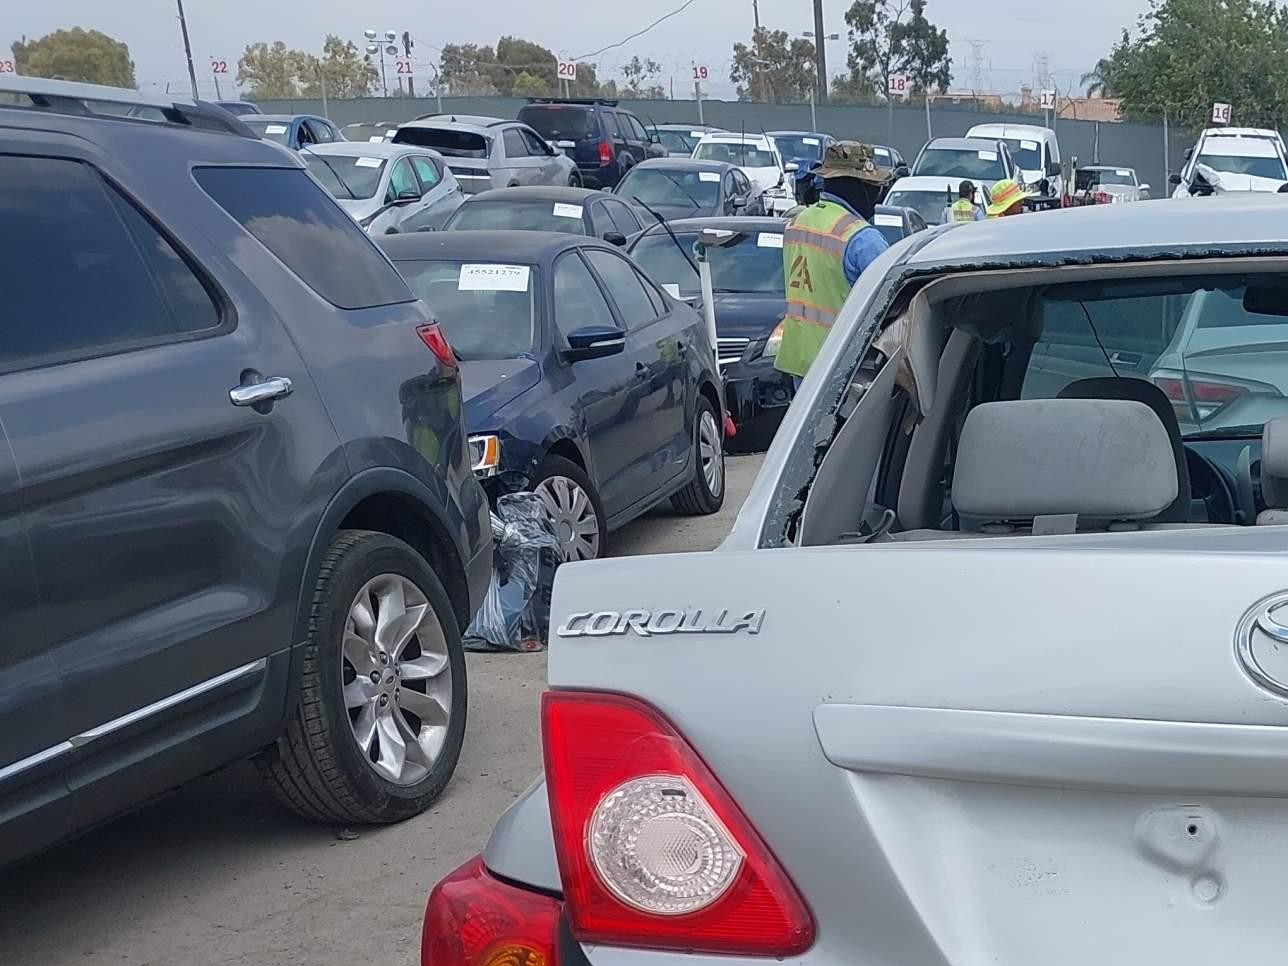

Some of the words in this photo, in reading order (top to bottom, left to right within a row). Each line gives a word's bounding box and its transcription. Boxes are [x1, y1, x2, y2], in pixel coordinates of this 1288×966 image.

[0, 61, 14, 73] 23
[211, 62, 227, 73] 22
[396, 62, 413, 73] 21
[559, 63, 574, 75] 20
[692, 67, 707, 79] 19
[889, 79, 904, 90] 18
[1042, 93, 1055, 105] 17
[1214, 107, 1229, 119] 16
[557, 608, 767, 637] COROLLA
